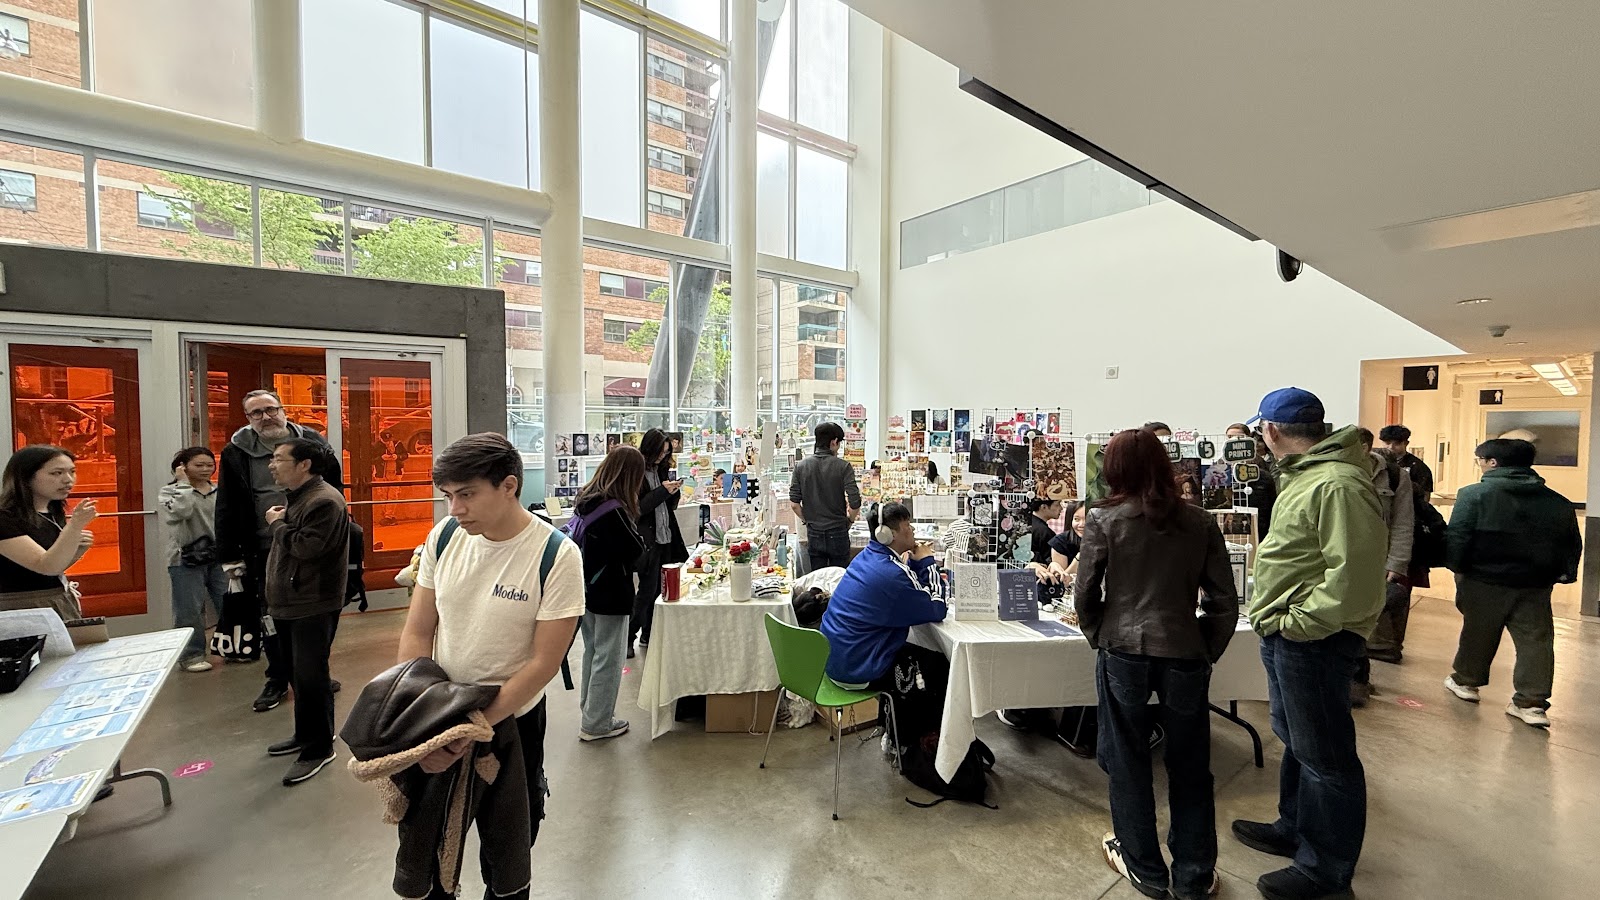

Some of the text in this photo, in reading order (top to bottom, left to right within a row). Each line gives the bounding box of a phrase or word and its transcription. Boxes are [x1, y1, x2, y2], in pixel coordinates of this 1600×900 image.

[1228, 450, 1252, 458] PRINTS
[1230, 554, 1245, 562] HERE
[492, 584, 529, 601] Modelo
